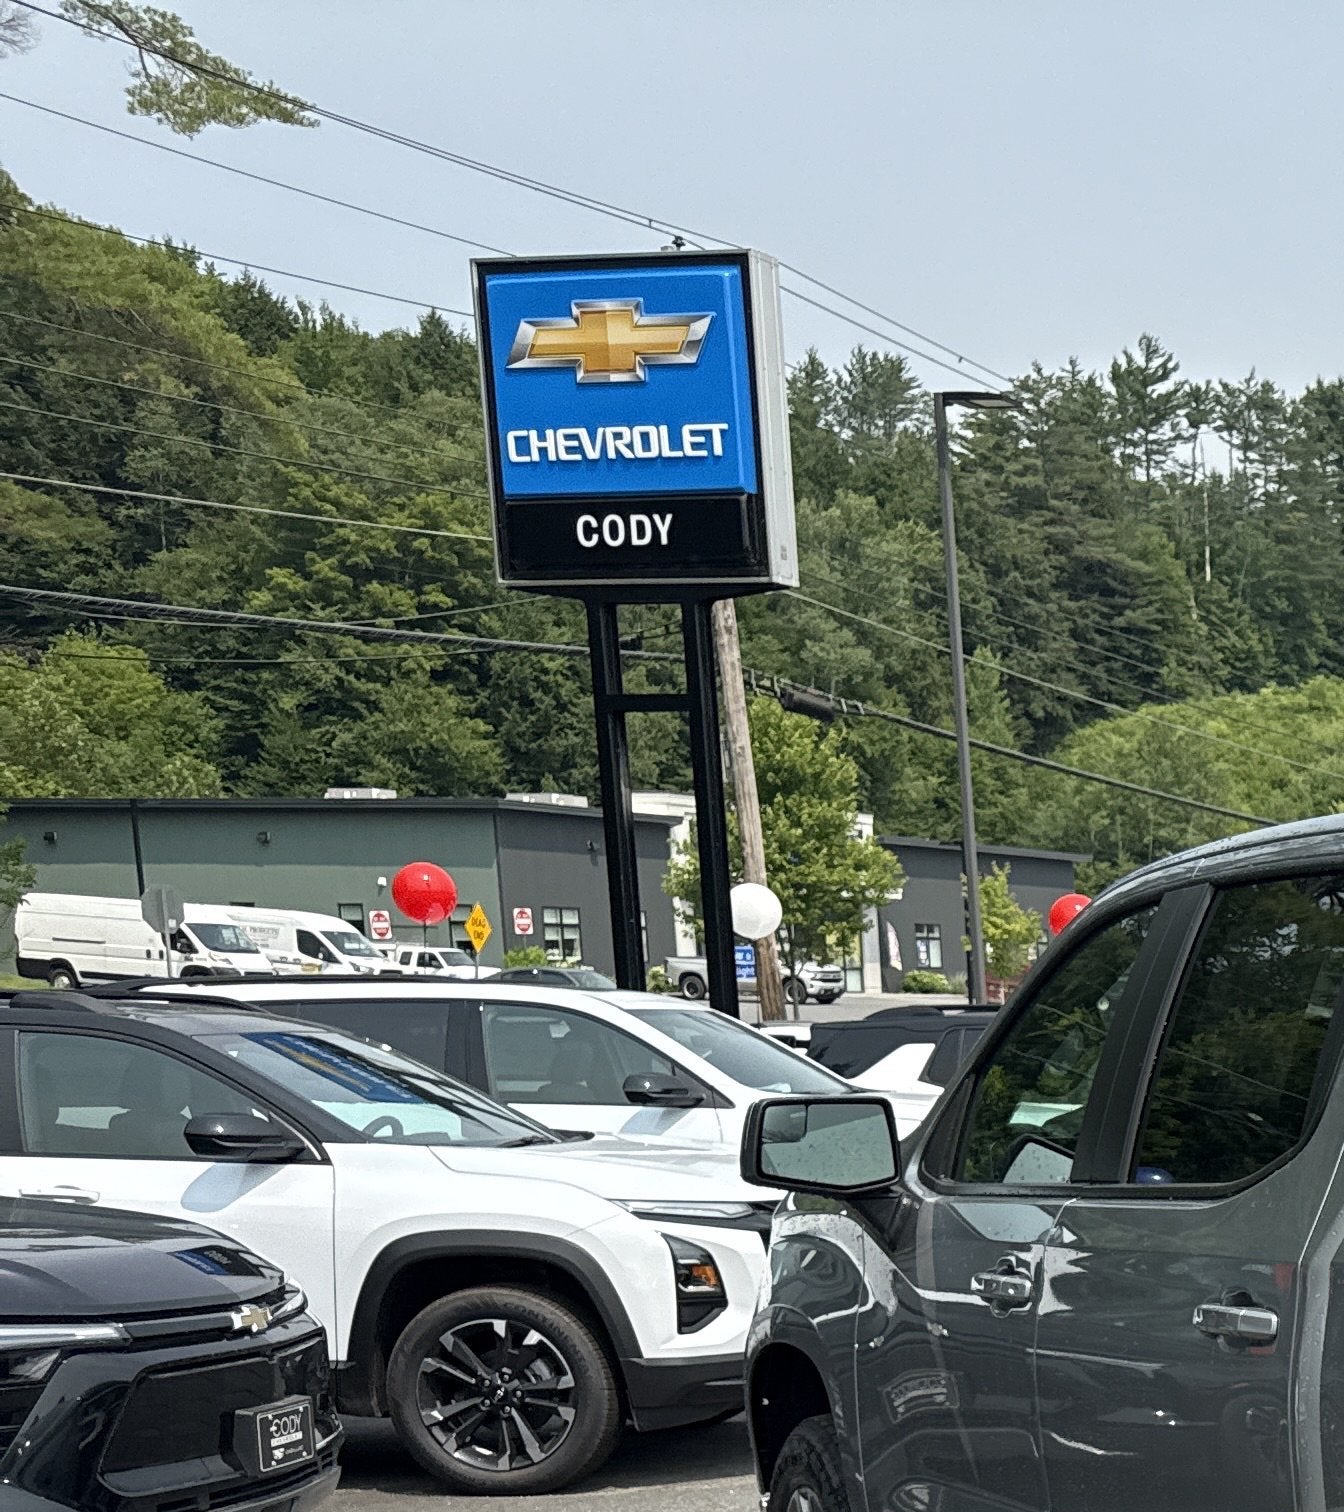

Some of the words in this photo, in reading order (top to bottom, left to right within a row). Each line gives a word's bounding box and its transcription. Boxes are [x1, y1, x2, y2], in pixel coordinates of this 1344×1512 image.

[507, 423, 729, 462] CHEVROLET
[576, 513, 673, 547] CODY
[271, 1413, 302, 1438] CODY
